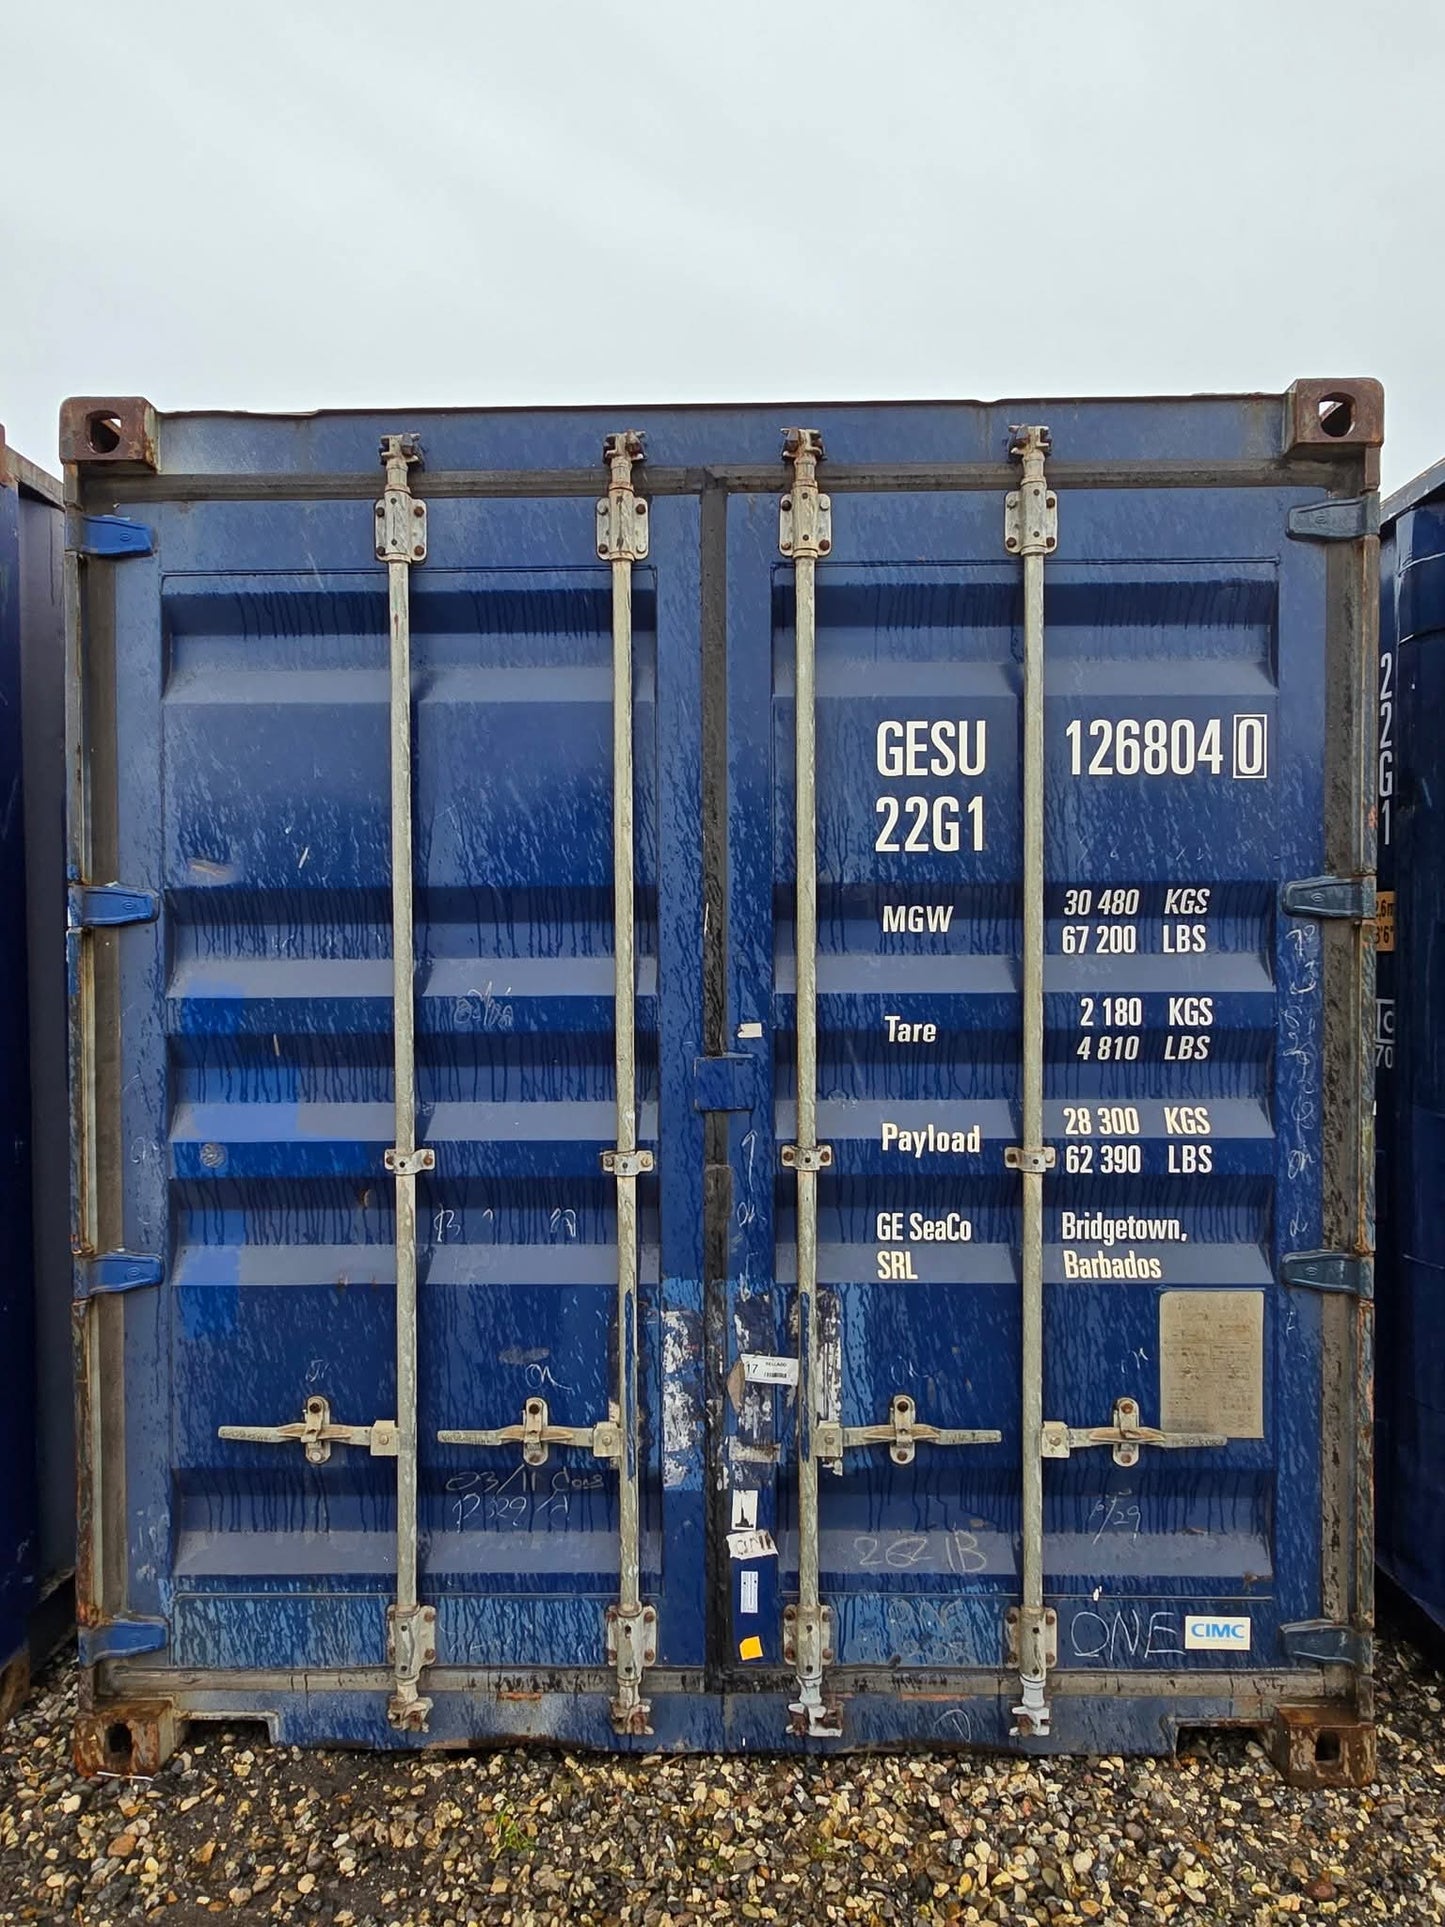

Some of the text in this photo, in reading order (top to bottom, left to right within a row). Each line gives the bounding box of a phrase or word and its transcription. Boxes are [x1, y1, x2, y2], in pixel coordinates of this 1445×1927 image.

[877, 716, 1265, 777] GESU 126804 0
[1379, 652, 1394, 846] 22G1
[875, 795, 983, 852] 22G1
[1064, 888, 1211, 916] 30 480 KGS
[882, 905, 954, 933] MGW
[1062, 924, 1207, 954] 67 200 LBS
[1080, 997, 1213, 1026] 2 180 KGS
[884, 1015, 937, 1043] Tare
[1076, 1035, 1211, 1060] 4 810 LBS
[1063, 1106, 1211, 1135] 28 300 KGS
[881, 1122, 981, 1158] Payload
[1066, 1145, 1213, 1174] 62 390 LBS
[876, 1212, 972, 1241] GE SeaCo
[1062, 1211, 1188, 1247] Bridgetown,
[876, 1250, 919, 1280] SRL
[1063, 1249, 1162, 1279] Barbados
[1071, 1609, 1187, 1661] ONE
[1190, 1622, 1246, 1639] CIMC
